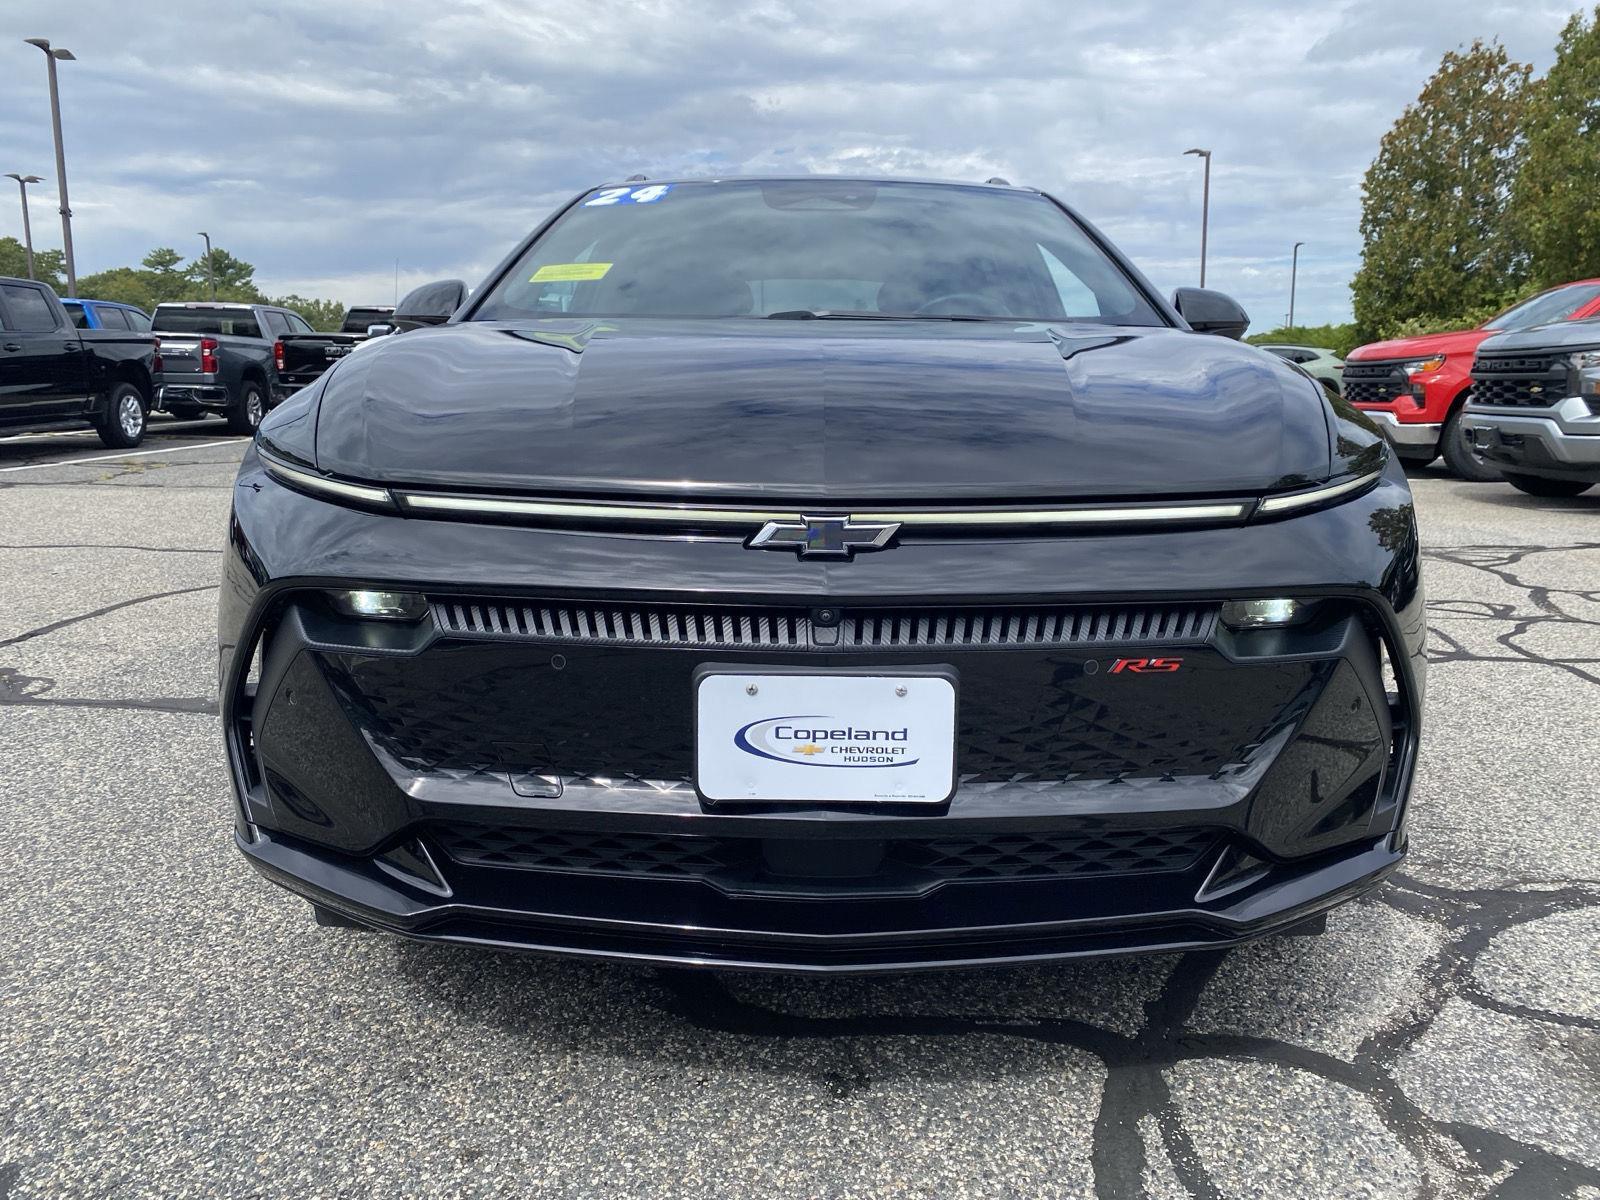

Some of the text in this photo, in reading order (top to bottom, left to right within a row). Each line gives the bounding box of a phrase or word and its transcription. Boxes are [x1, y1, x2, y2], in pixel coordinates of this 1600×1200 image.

[584, 184, 670, 207] 24
[324, 346, 356, 356] GM
[1107, 657, 1184, 673] RS
[774, 726, 908, 742] Copeland
[830, 746, 907, 755] CHEVROLET
